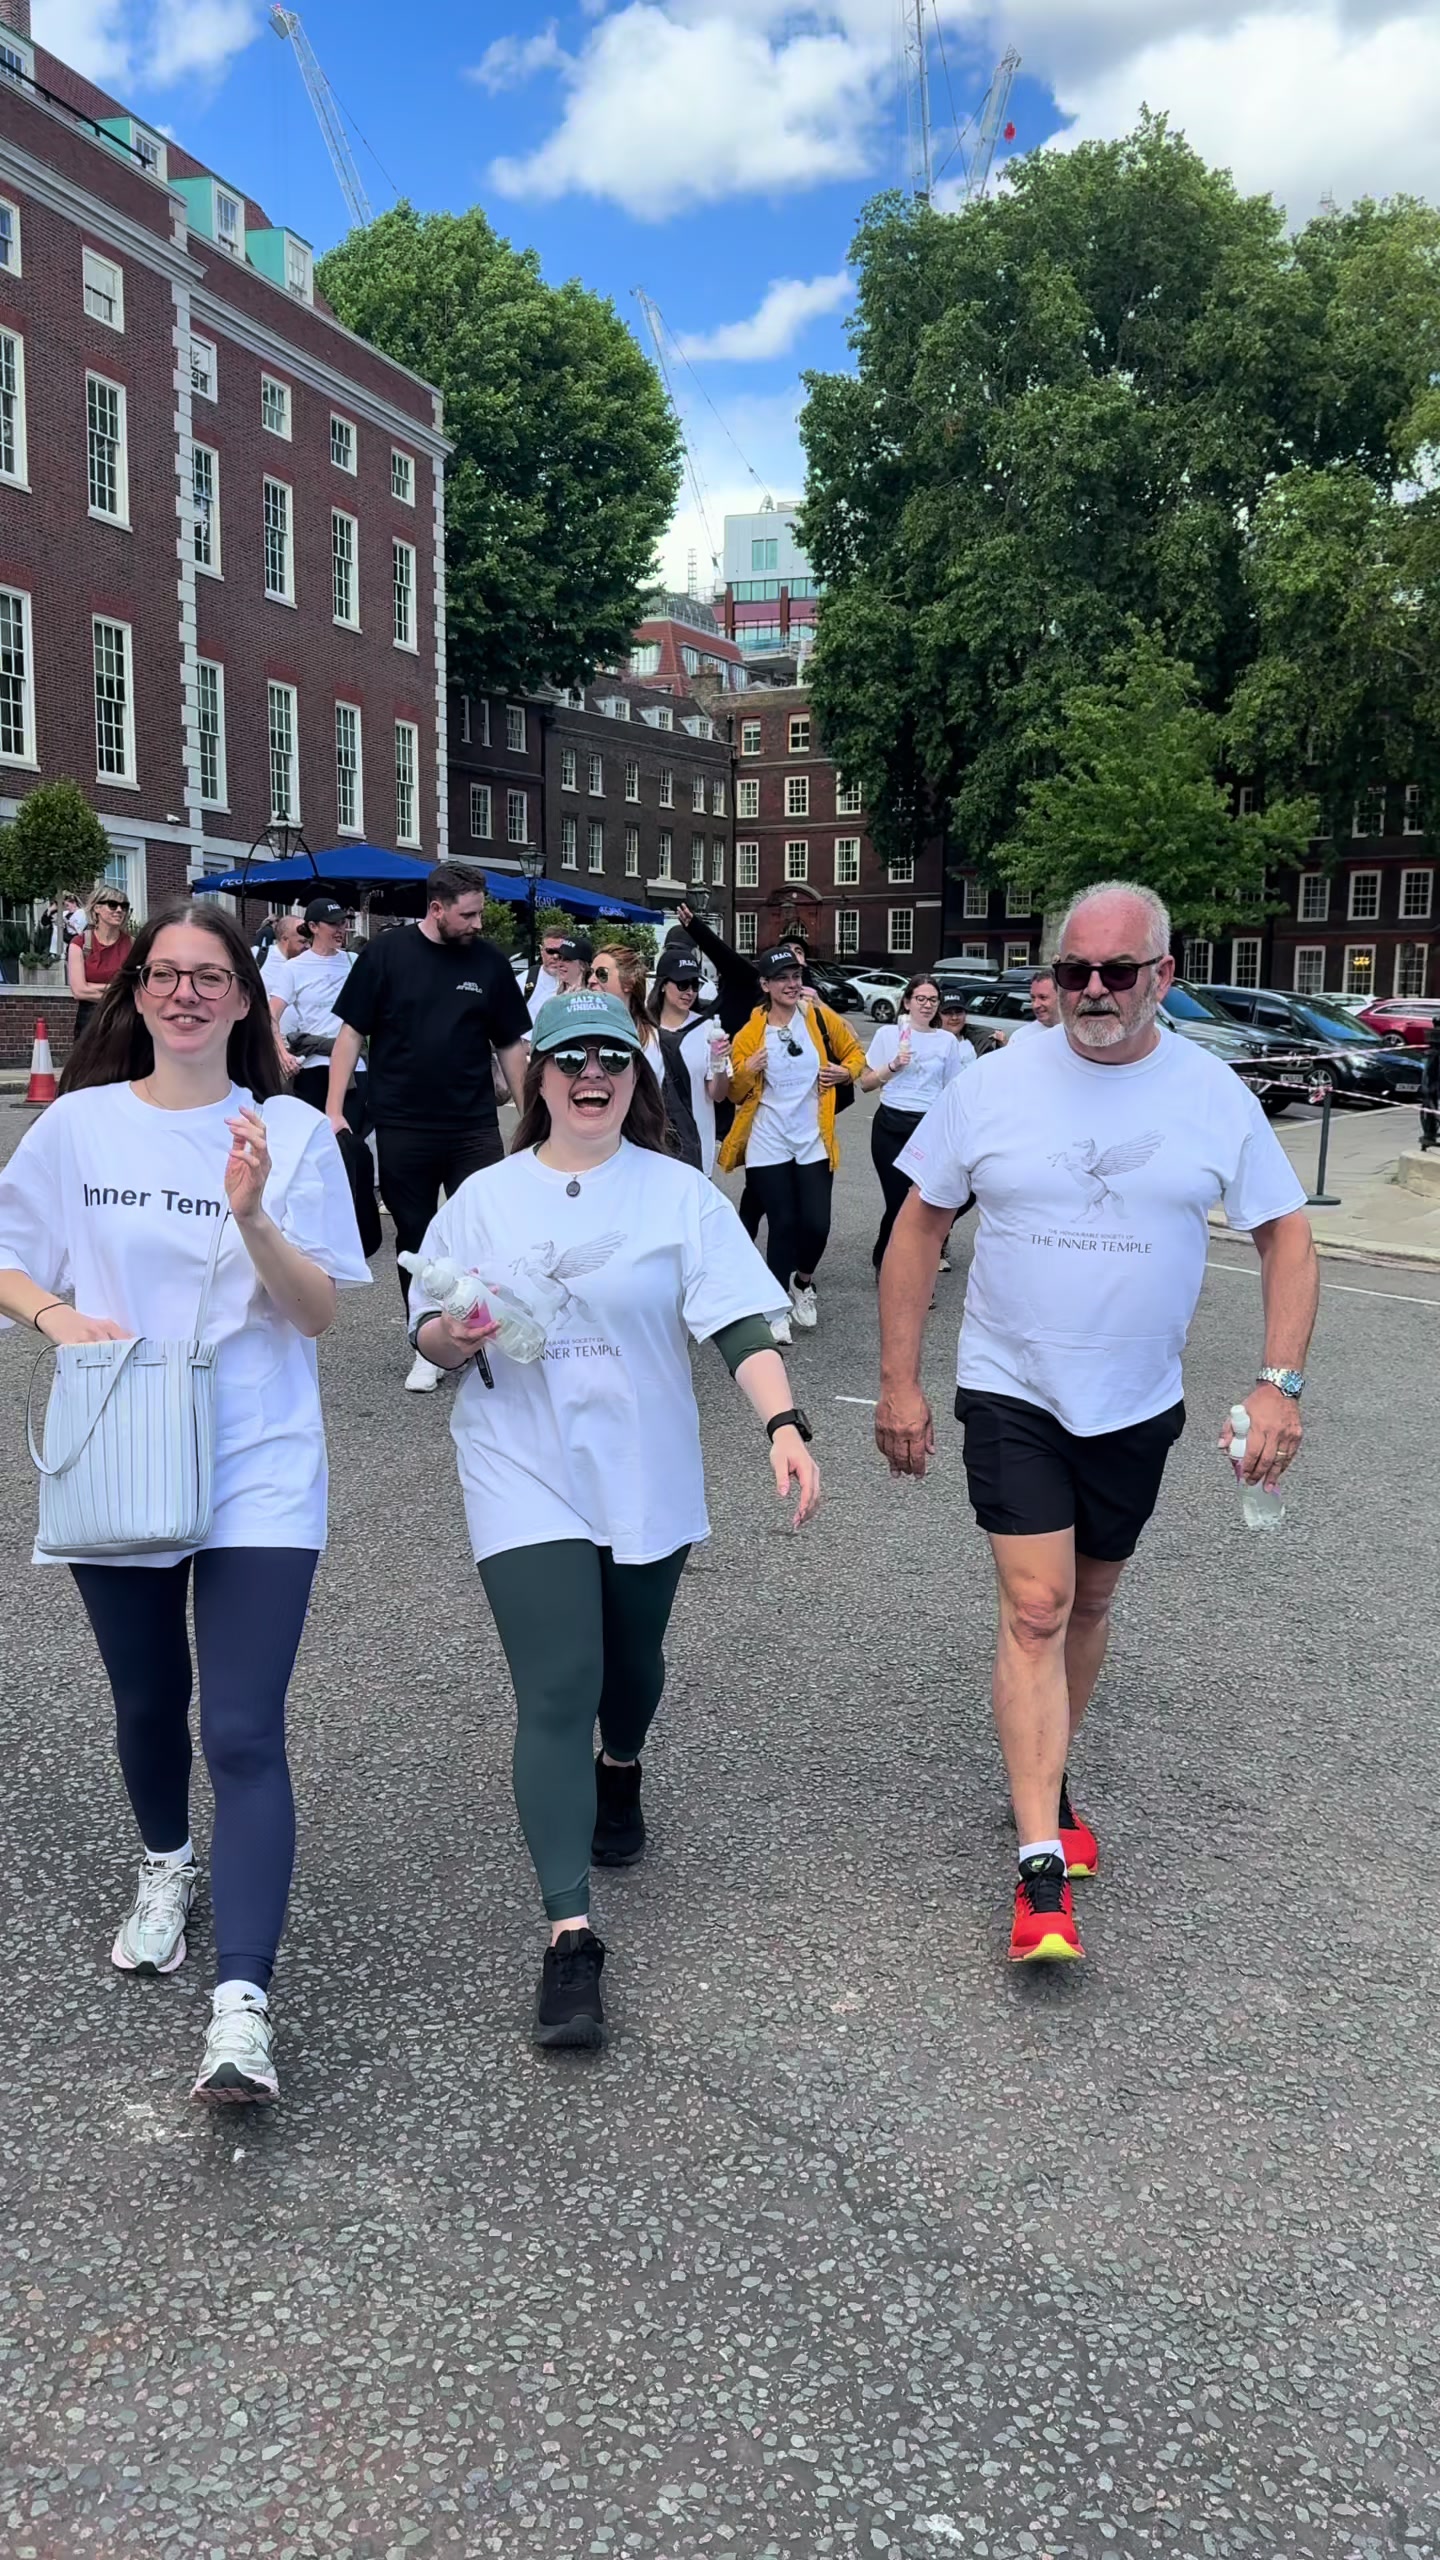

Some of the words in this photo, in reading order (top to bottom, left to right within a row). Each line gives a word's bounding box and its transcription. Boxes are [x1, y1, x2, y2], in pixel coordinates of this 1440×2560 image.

[566, 1003, 609, 1013] VINEGAR
[83, 1184, 152, 1207] Inner
[161, 1189, 233, 1220] Tem
[1030, 1233, 1054, 1247] THE
[1058, 1237, 1097, 1251] INNER
[1101, 1240, 1152, 1254] TEMPLE
[573, 1342, 622, 1357] TEMPLE
